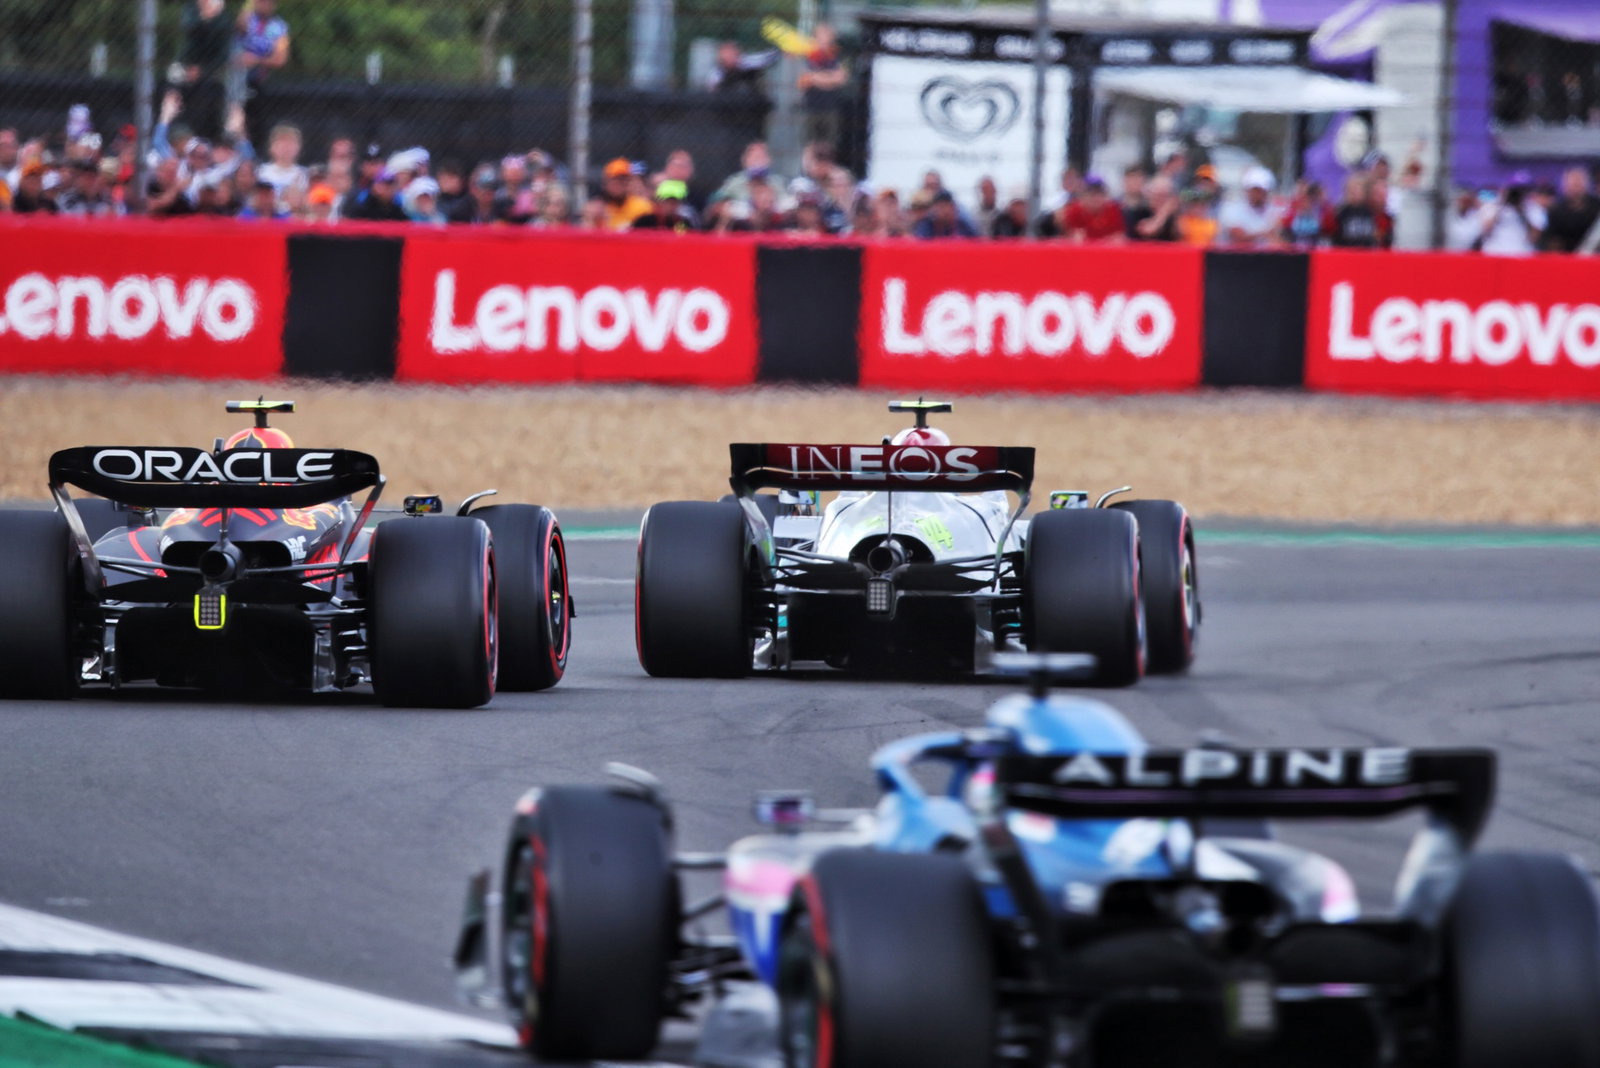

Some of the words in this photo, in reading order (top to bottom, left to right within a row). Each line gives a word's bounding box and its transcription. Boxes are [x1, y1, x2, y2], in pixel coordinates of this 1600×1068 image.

[0, 272, 256, 341] enovo
[430, 269, 730, 354] Lenovo
[881, 277, 1176, 358] Lenovo
[1328, 281, 1600, 368] Lenovo
[93, 448, 336, 483] ORACLE
[787, 445, 979, 482] INEOS
[1054, 747, 1410, 786] ALPINE
